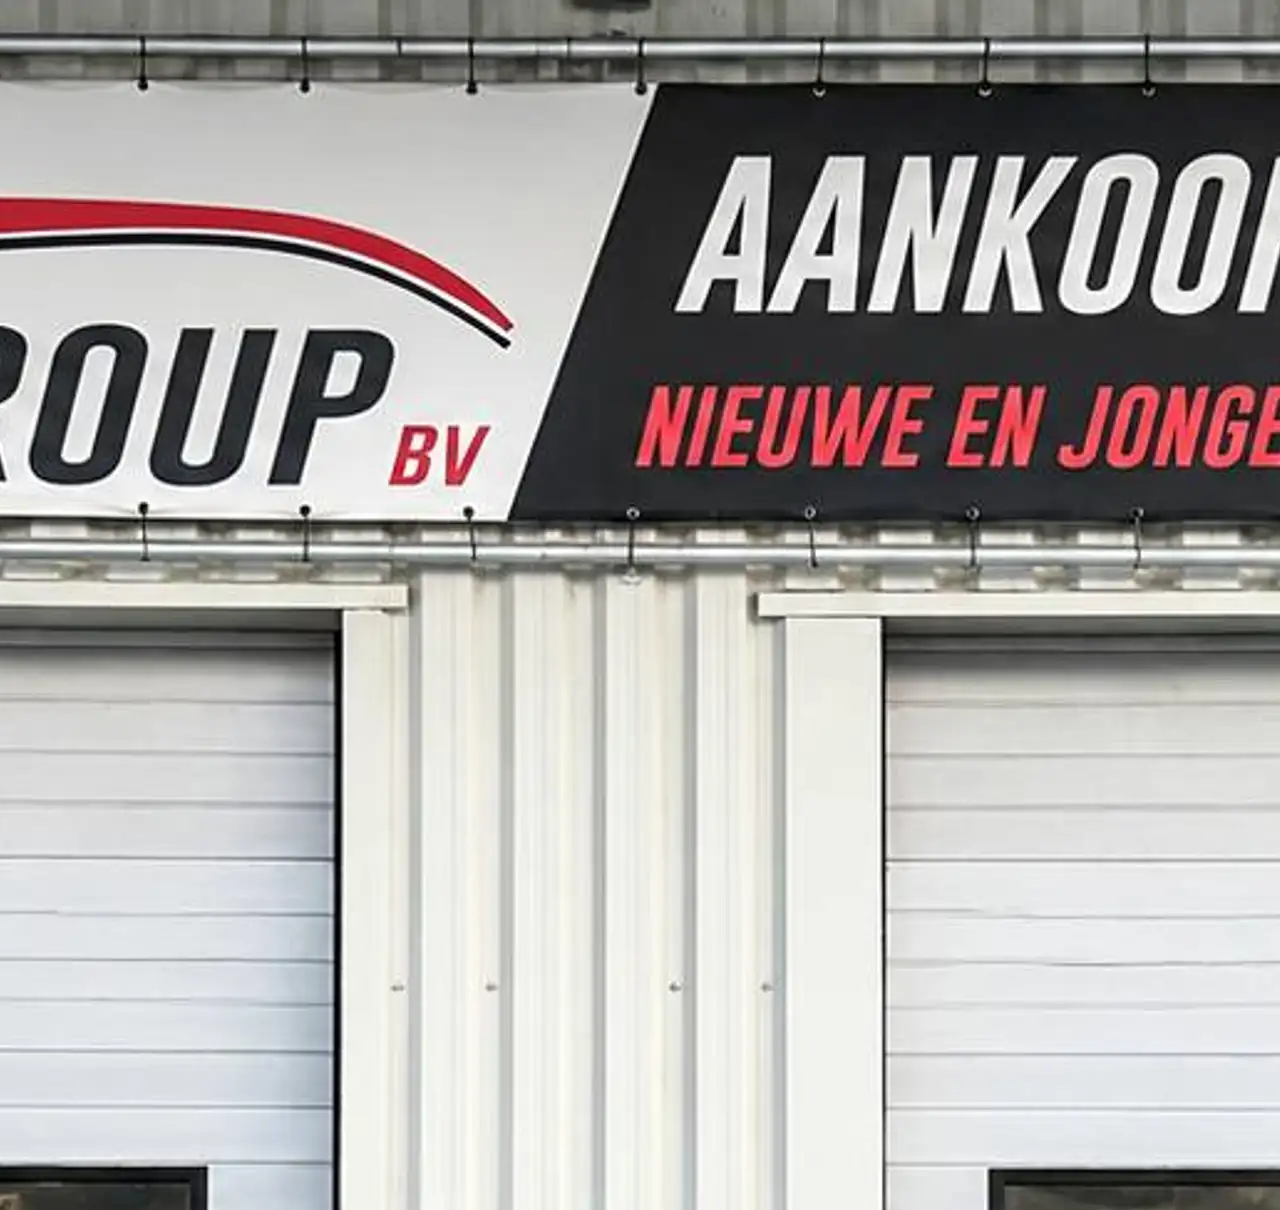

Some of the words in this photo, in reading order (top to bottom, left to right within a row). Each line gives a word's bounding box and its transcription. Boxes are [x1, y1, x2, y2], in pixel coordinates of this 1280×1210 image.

[388, 425, 490, 487] BV
[637, 384, 933, 469] NIEUWE
[946, 384, 1047, 469] EN
